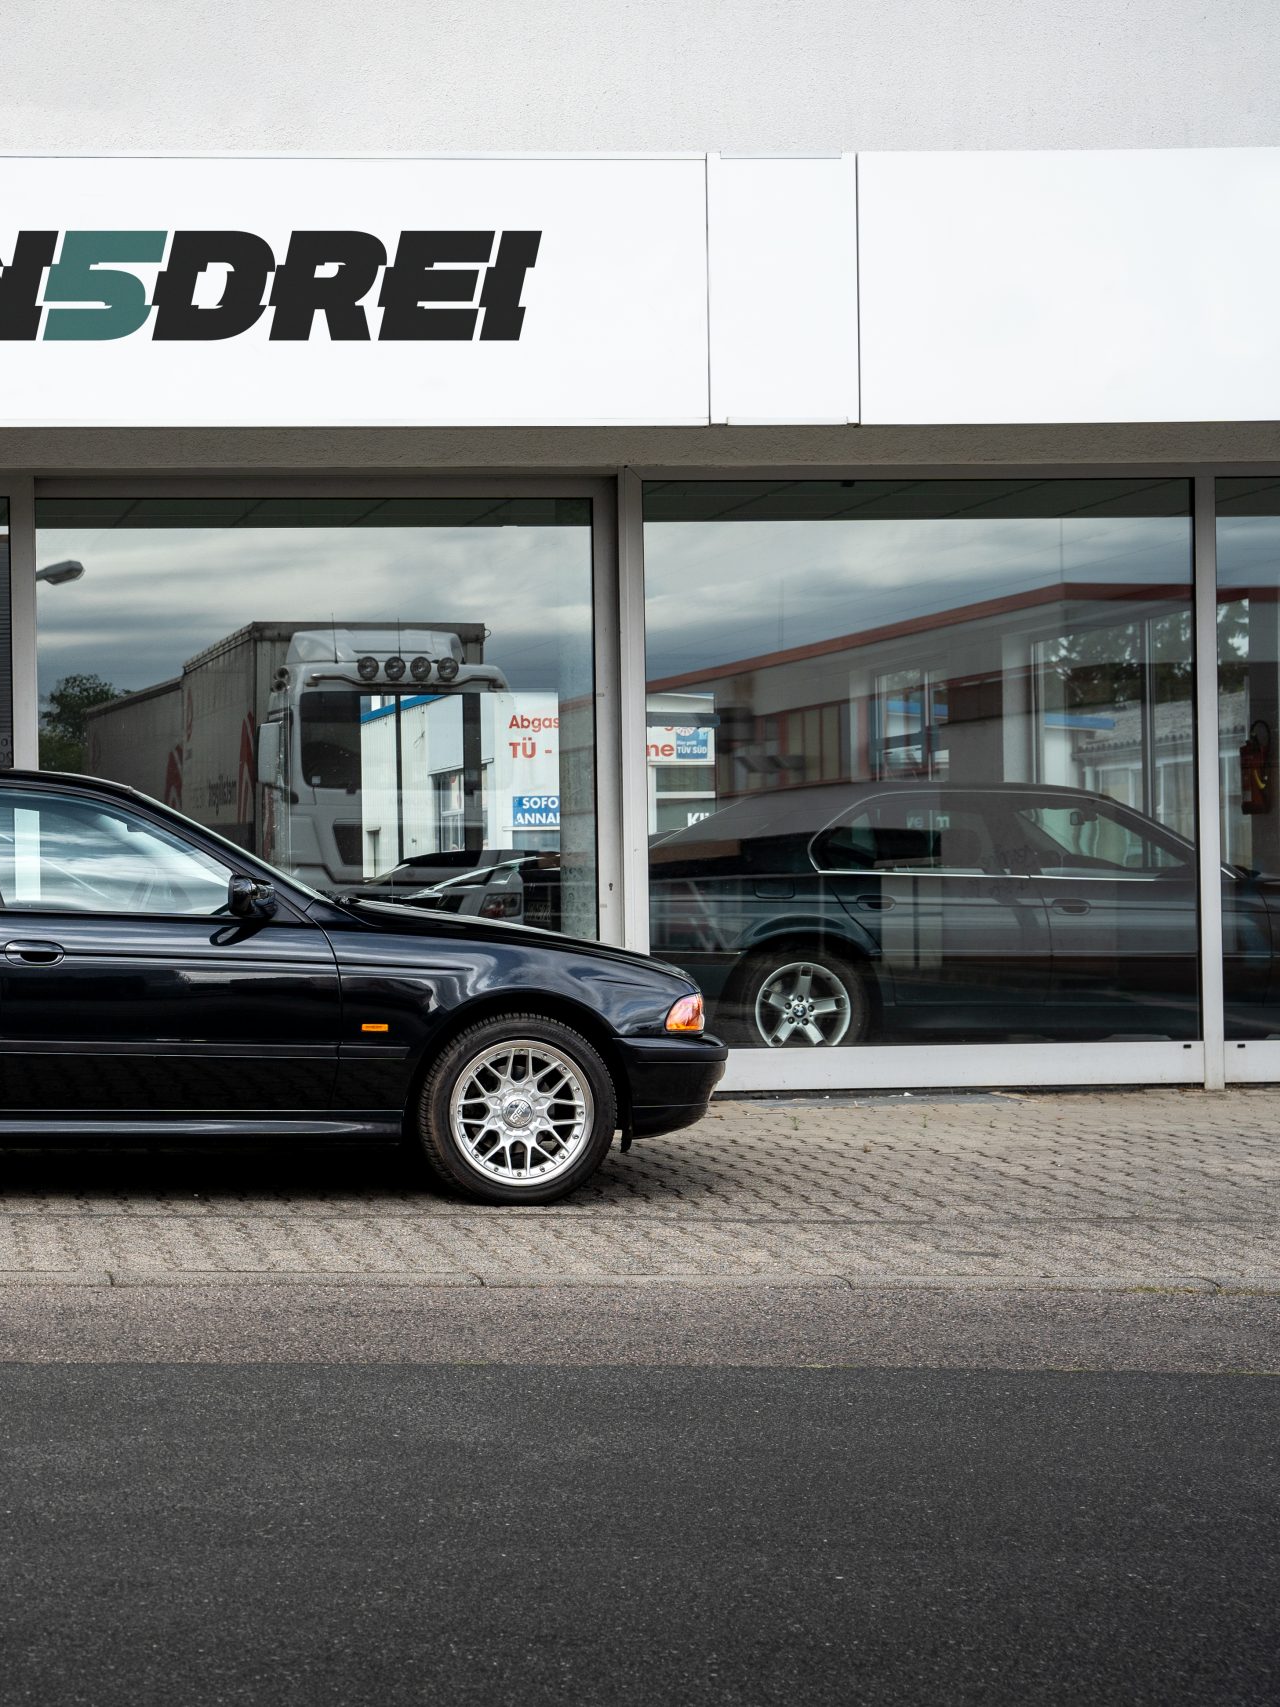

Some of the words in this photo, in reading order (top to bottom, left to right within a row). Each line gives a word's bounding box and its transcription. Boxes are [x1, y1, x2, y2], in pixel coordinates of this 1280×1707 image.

[677, 744, 691, 754] TÜV
[692, 744, 707, 754] SÜD
[522, 797, 559, 809] SOFO
